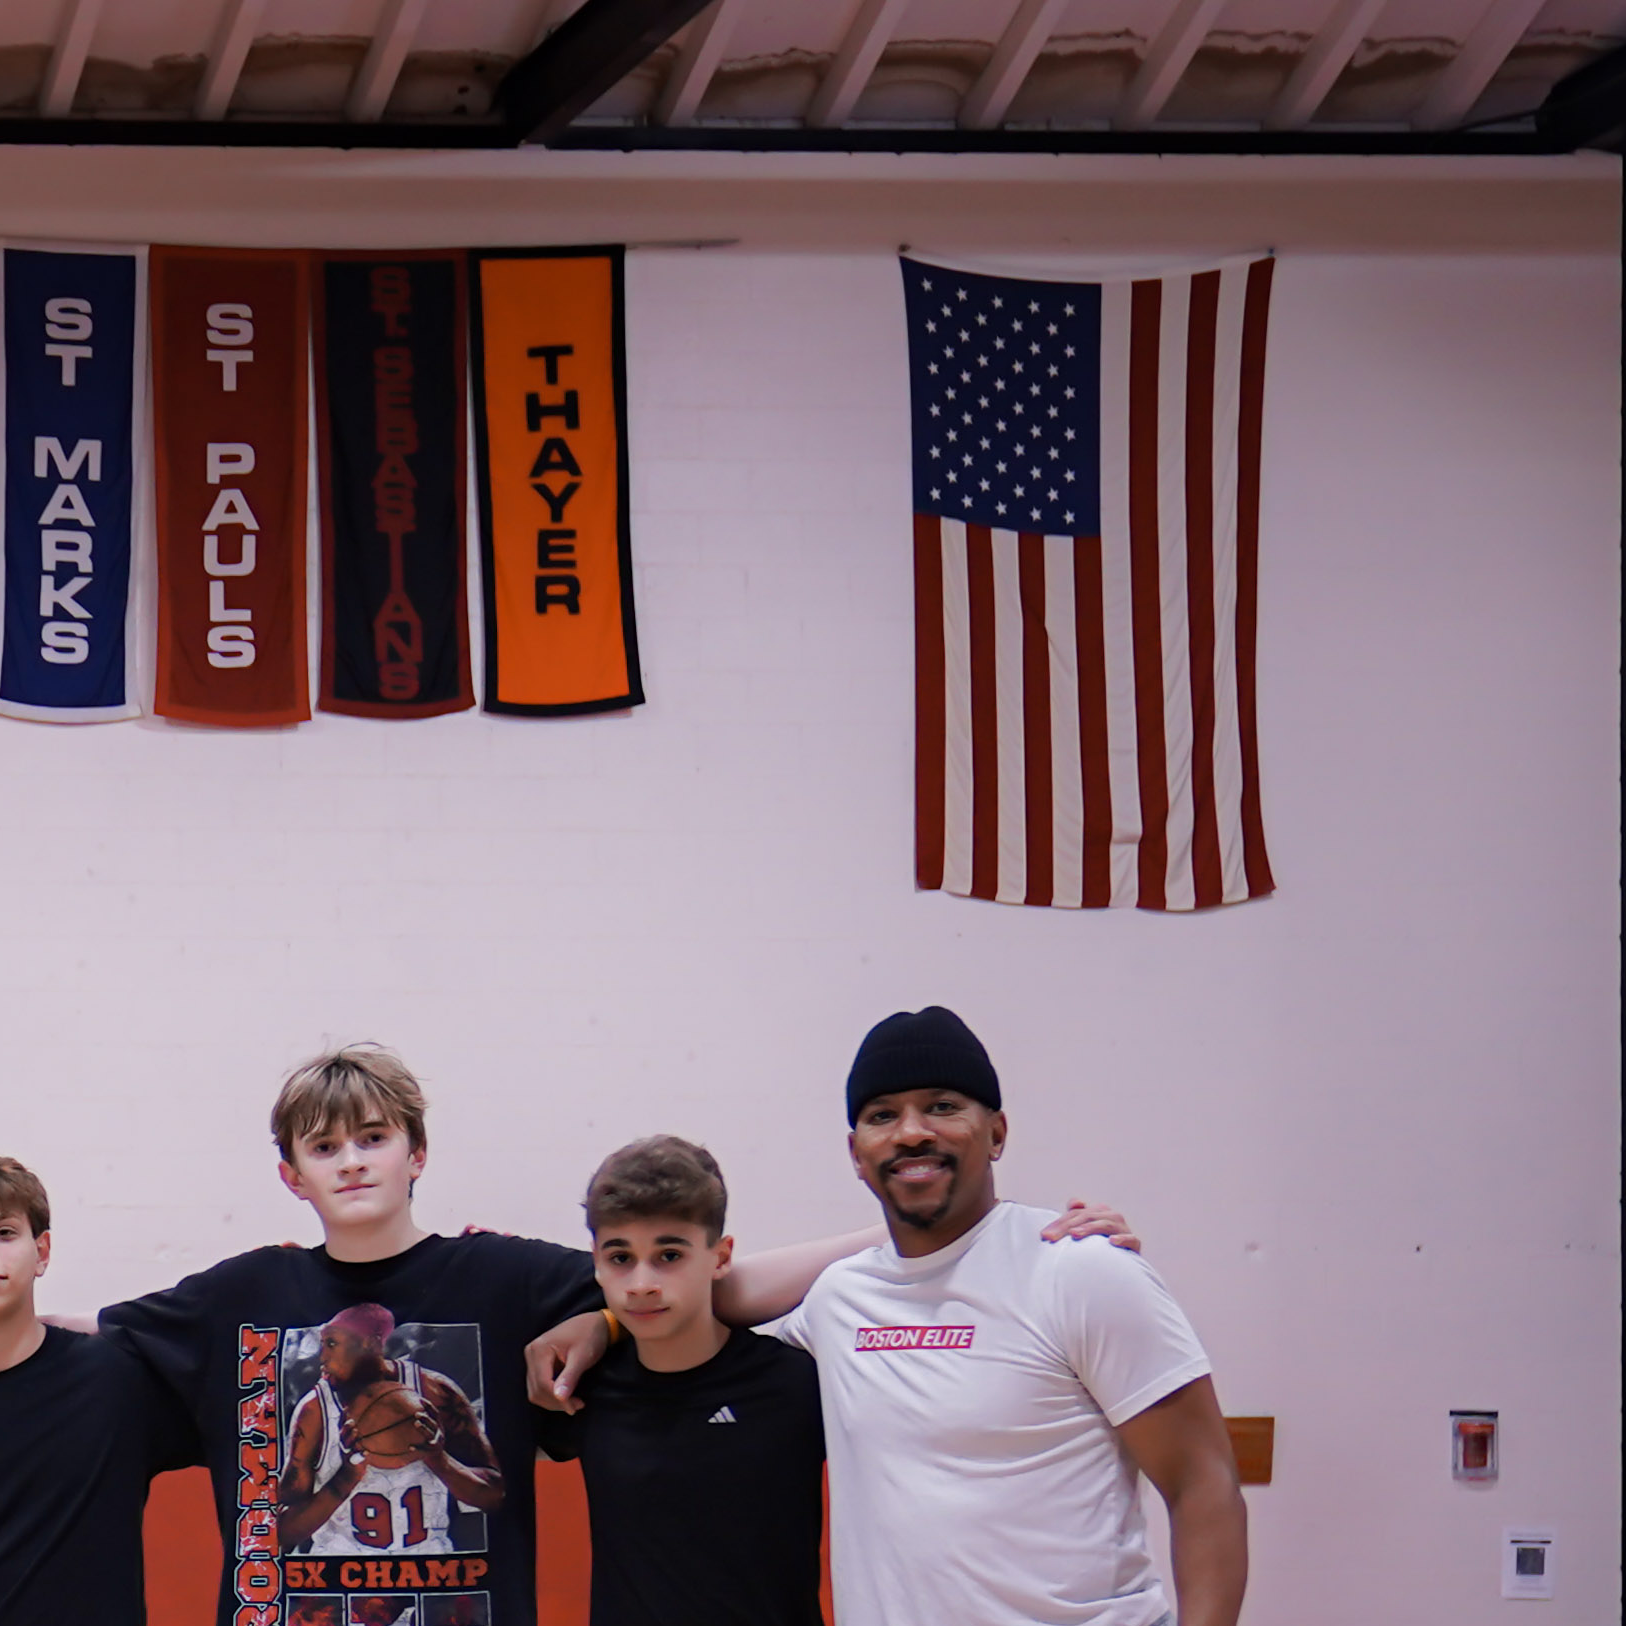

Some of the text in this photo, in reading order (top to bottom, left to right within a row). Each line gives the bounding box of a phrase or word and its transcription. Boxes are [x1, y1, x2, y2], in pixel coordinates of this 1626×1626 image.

[33, 297, 103, 665] ST MARKS
[201, 302, 260, 669] ST PAULS
[371, 345, 423, 699] SEBASTIANS
[525, 344, 584, 616] THAYER
[856, 1329, 973, 1348] BOSTON ELITE
[285, 1558, 489, 1588] 5X CHAMP
[350, 1485, 429, 1549] 91
